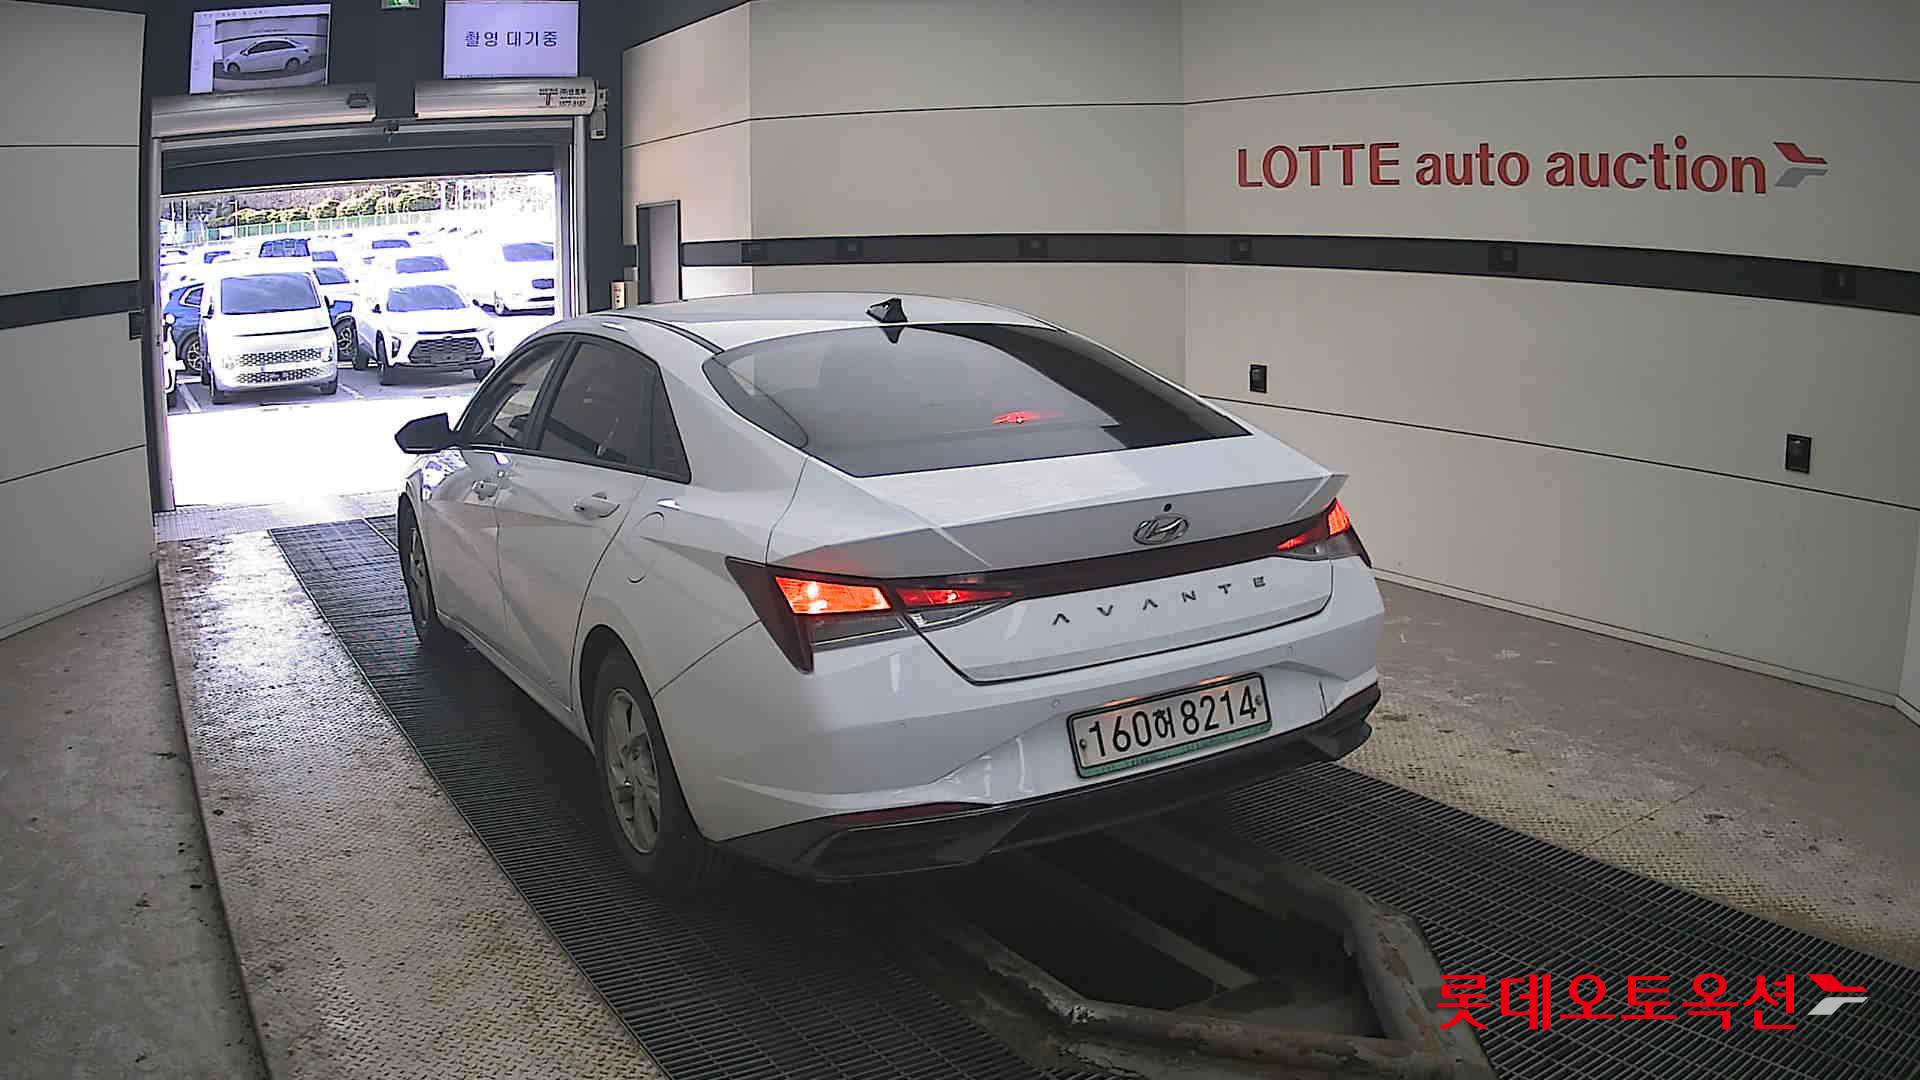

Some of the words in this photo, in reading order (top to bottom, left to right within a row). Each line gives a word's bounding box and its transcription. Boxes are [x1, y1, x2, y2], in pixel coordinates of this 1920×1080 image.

[465, 31, 498, 47] 촬영
[506, 31, 557, 47] 대기중
[1237, 142, 1400, 188] LOTTE
[1415, 143, 1530, 187] auto
[1546, 135, 1767, 194] auction
[1052, 576, 1266, 625] AVANTE
